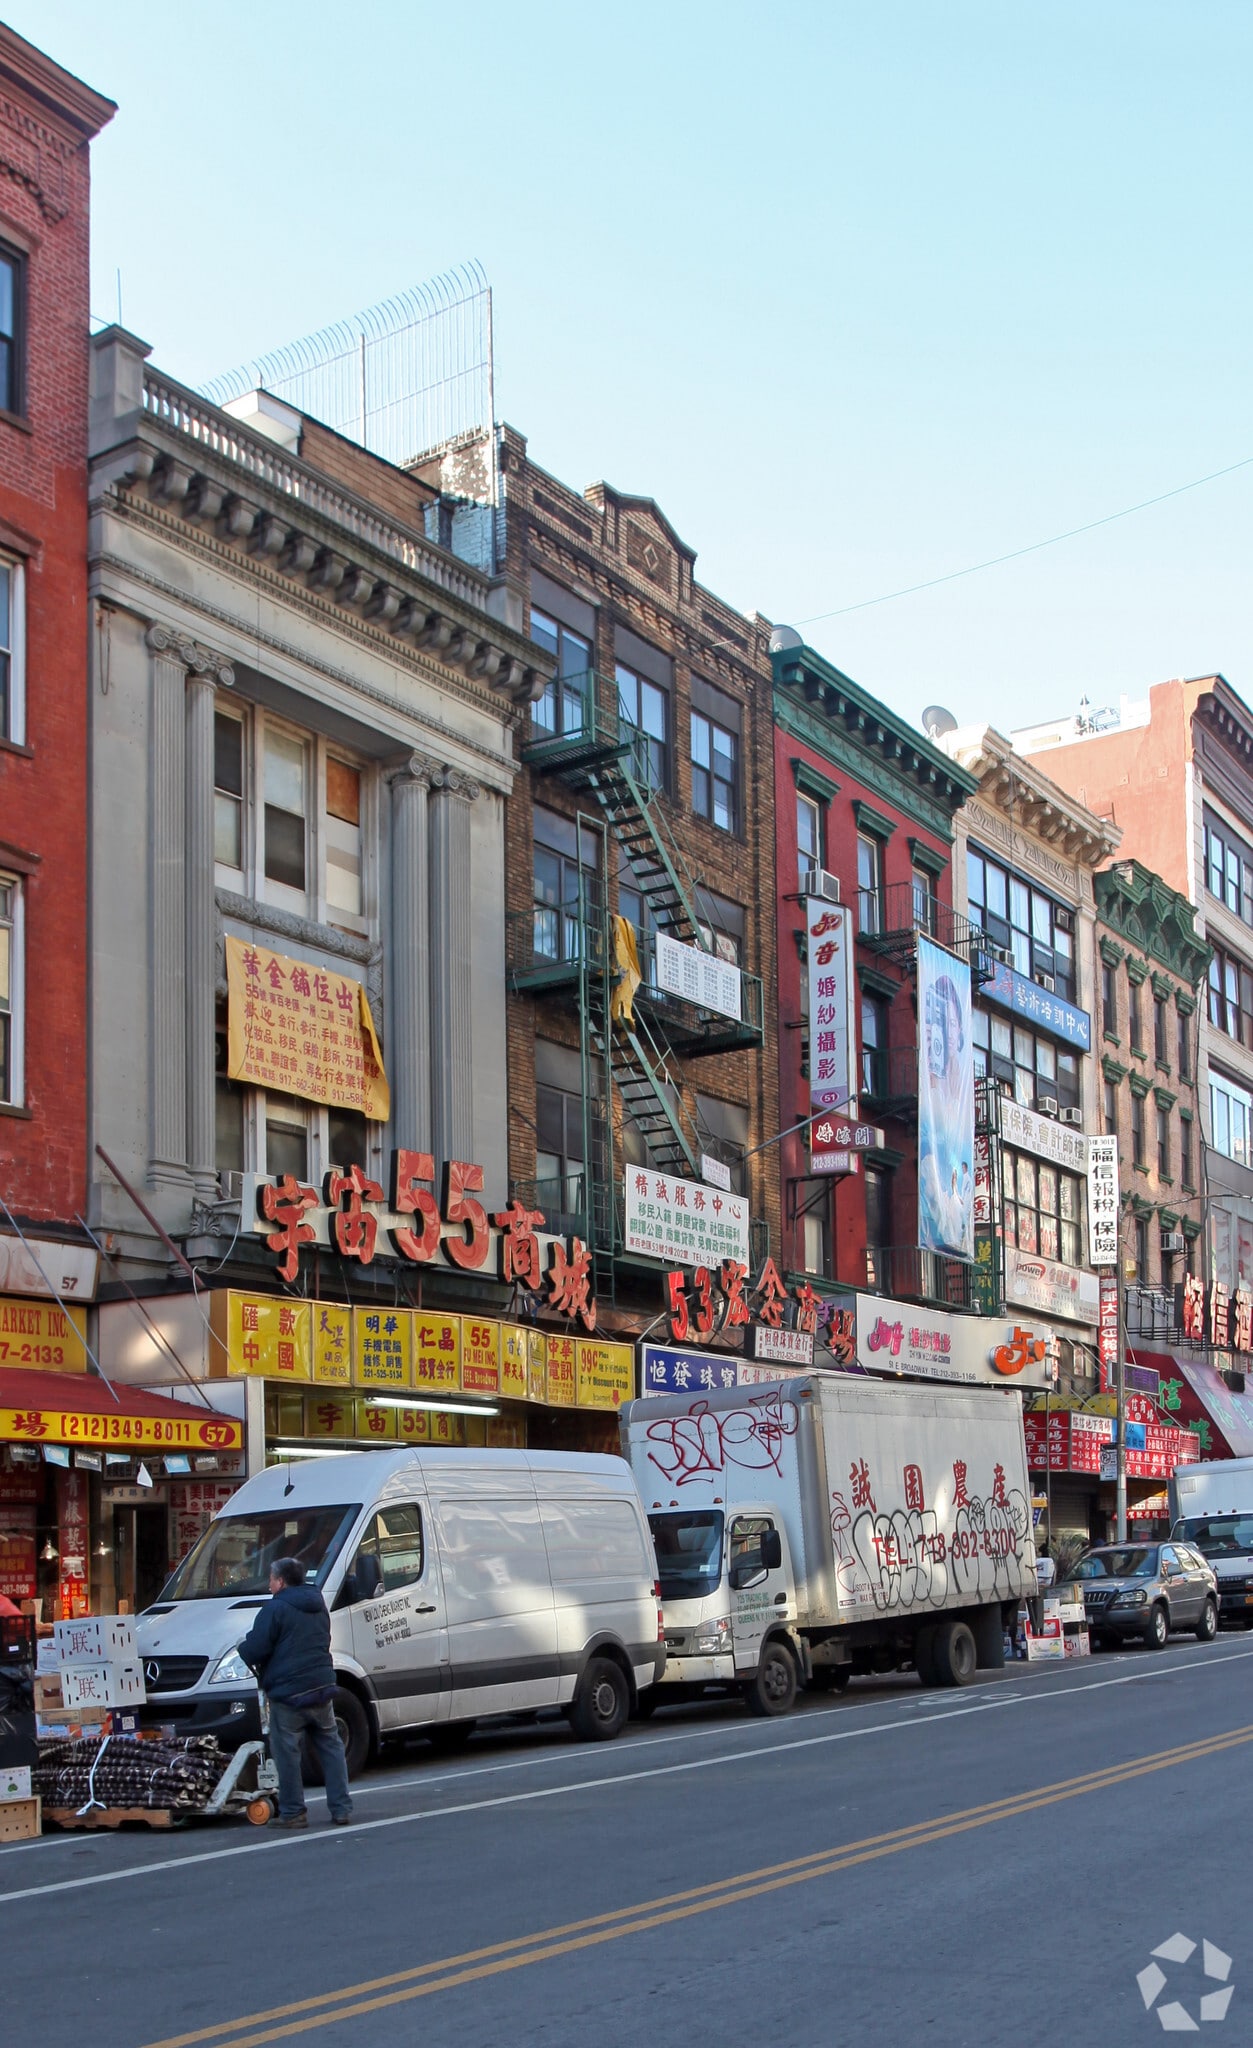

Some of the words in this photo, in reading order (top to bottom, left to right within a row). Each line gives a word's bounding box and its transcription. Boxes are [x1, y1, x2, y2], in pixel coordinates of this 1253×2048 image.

[824, 1093, 836, 1102] 51
[812, 1154, 848, 1170] 212-393-1166
[635, 1173, 741, 1219] 精誠服務中心
[62, 1277, 78, 1290] 57
[0, 1306, 42, 1335] ARKET
[242, 1303, 295, 1336] 匯款
[365, 1315, 399, 1336] 明華
[418, 1326, 455, 1352] 仁晶
[470, 1326, 491, 1348] 55
[242, 1339, 294, 1371] 中國
[464, 1347, 471, 1362] FU
[548, 1338, 573, 1360] 中華
[901, 1363, 928, 1374] BROADWAY
[11, 1411, 49, 1437] 場
[205, 1426, 228, 1443] 57
[849, 1457, 1010, 1513] 誠園農產
[389, 1617, 408, 1629] Broadway
[71, 1630, 88, 1653] 联
[78, 1676, 96, 1699] 联
